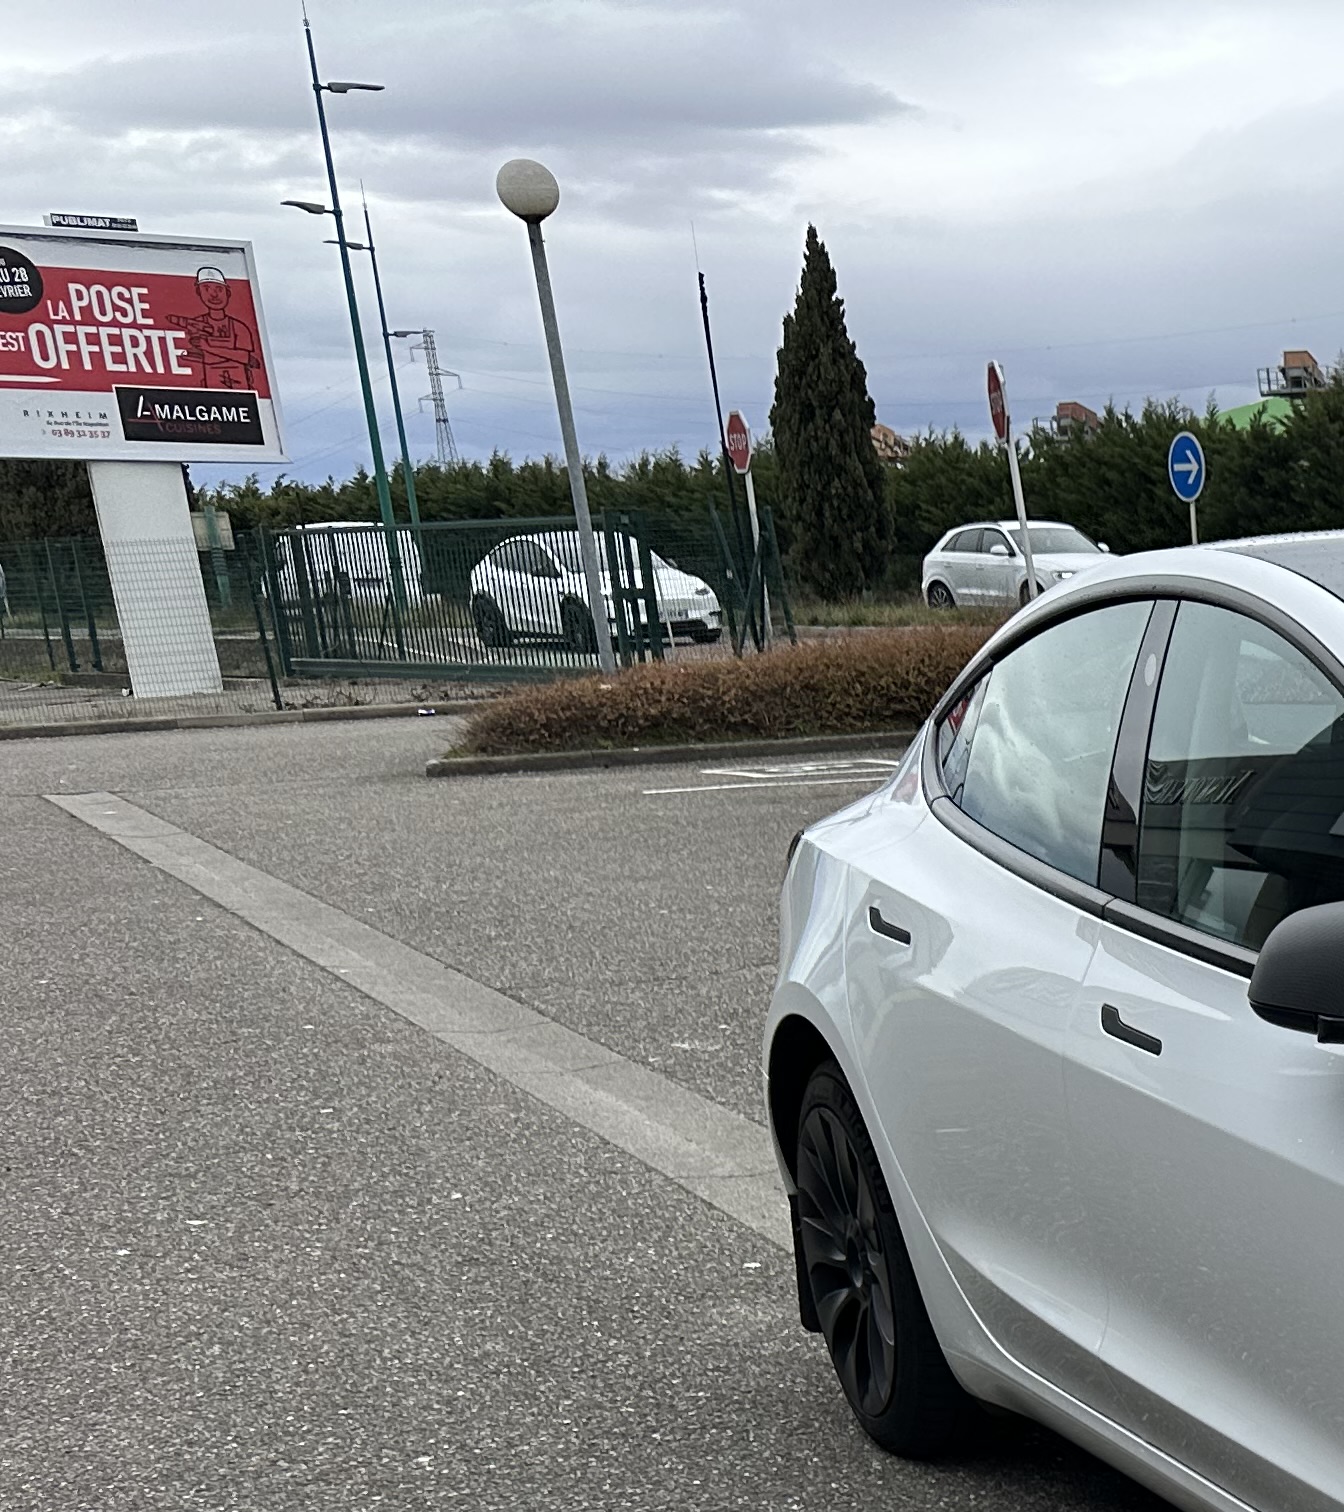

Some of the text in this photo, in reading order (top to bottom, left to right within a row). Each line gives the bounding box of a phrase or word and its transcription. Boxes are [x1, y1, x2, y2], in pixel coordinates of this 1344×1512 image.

[11, 267, 29, 282] 28
[0, 284, 32, 298] VRIER
[47, 283, 154, 324] LA POSE
[0, 323, 192, 376] EST OFFERTE
[165, 422, 221, 435] CUISINES
[729, 433, 747, 451] STOP
